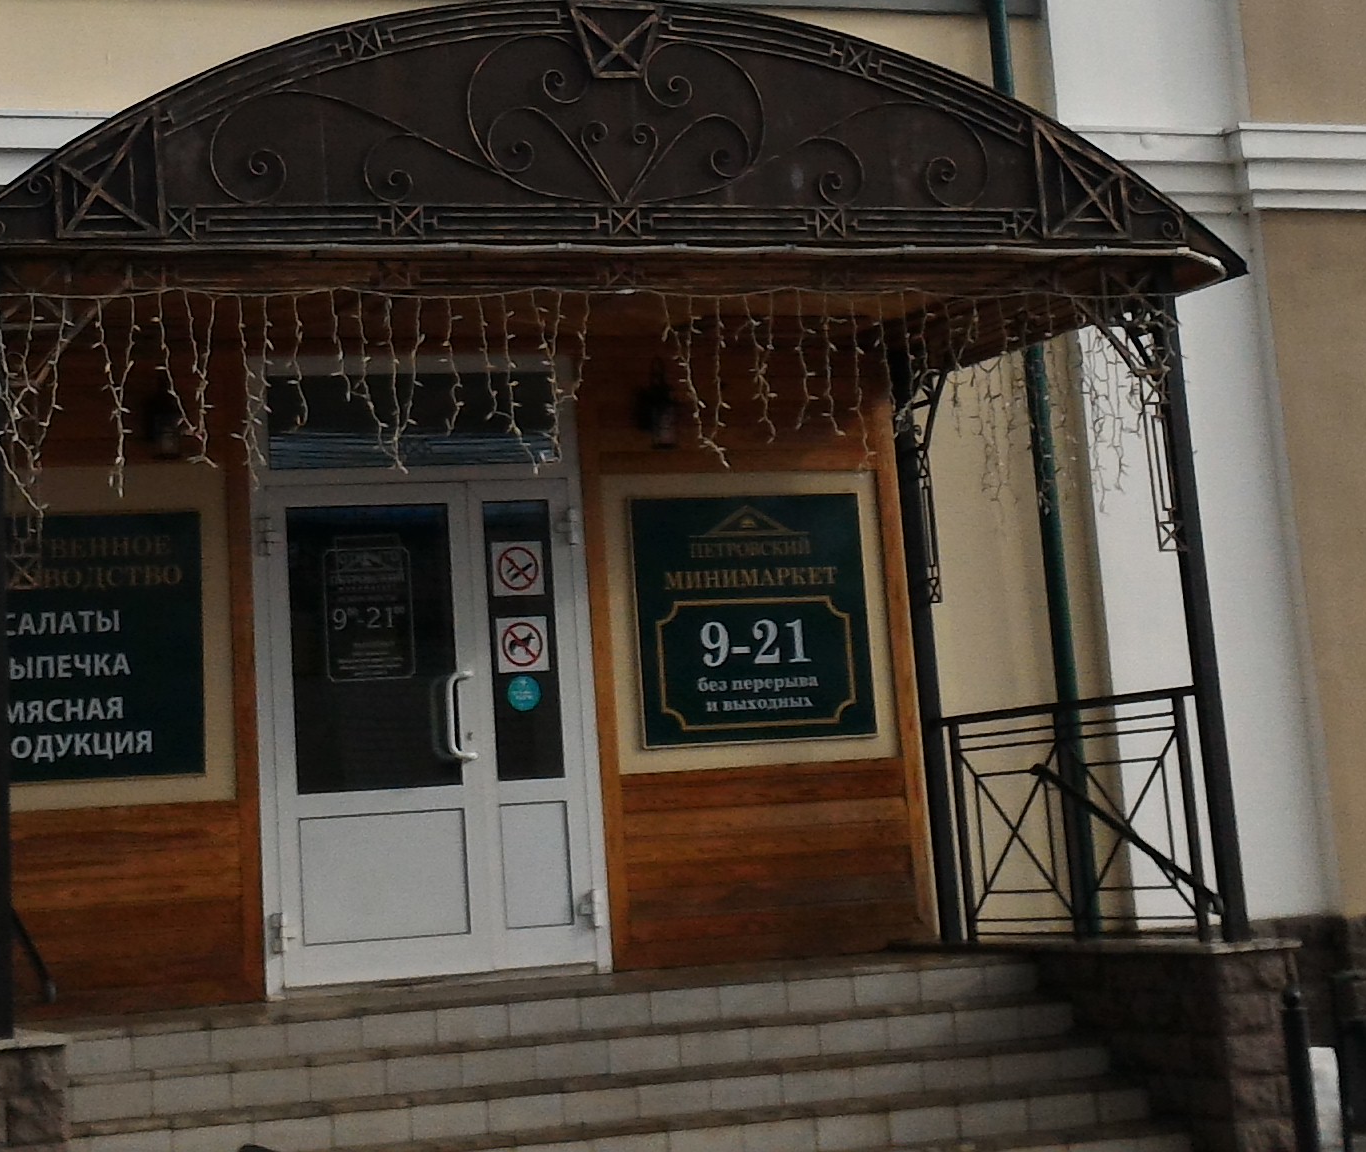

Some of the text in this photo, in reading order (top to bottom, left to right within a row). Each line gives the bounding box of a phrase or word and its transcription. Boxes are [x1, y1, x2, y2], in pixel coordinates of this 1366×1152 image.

[664, 566, 837, 590] МИНИМАРКЕТ
[700, 618, 812, 668] 9-21
[8, 652, 132, 681] ЫПЕЧКА
[697, 676, 819, 693] без перерыва
[706, 696, 815, 713] и выходных
[11, 730, 153, 763] ОДУКЦИЯ
